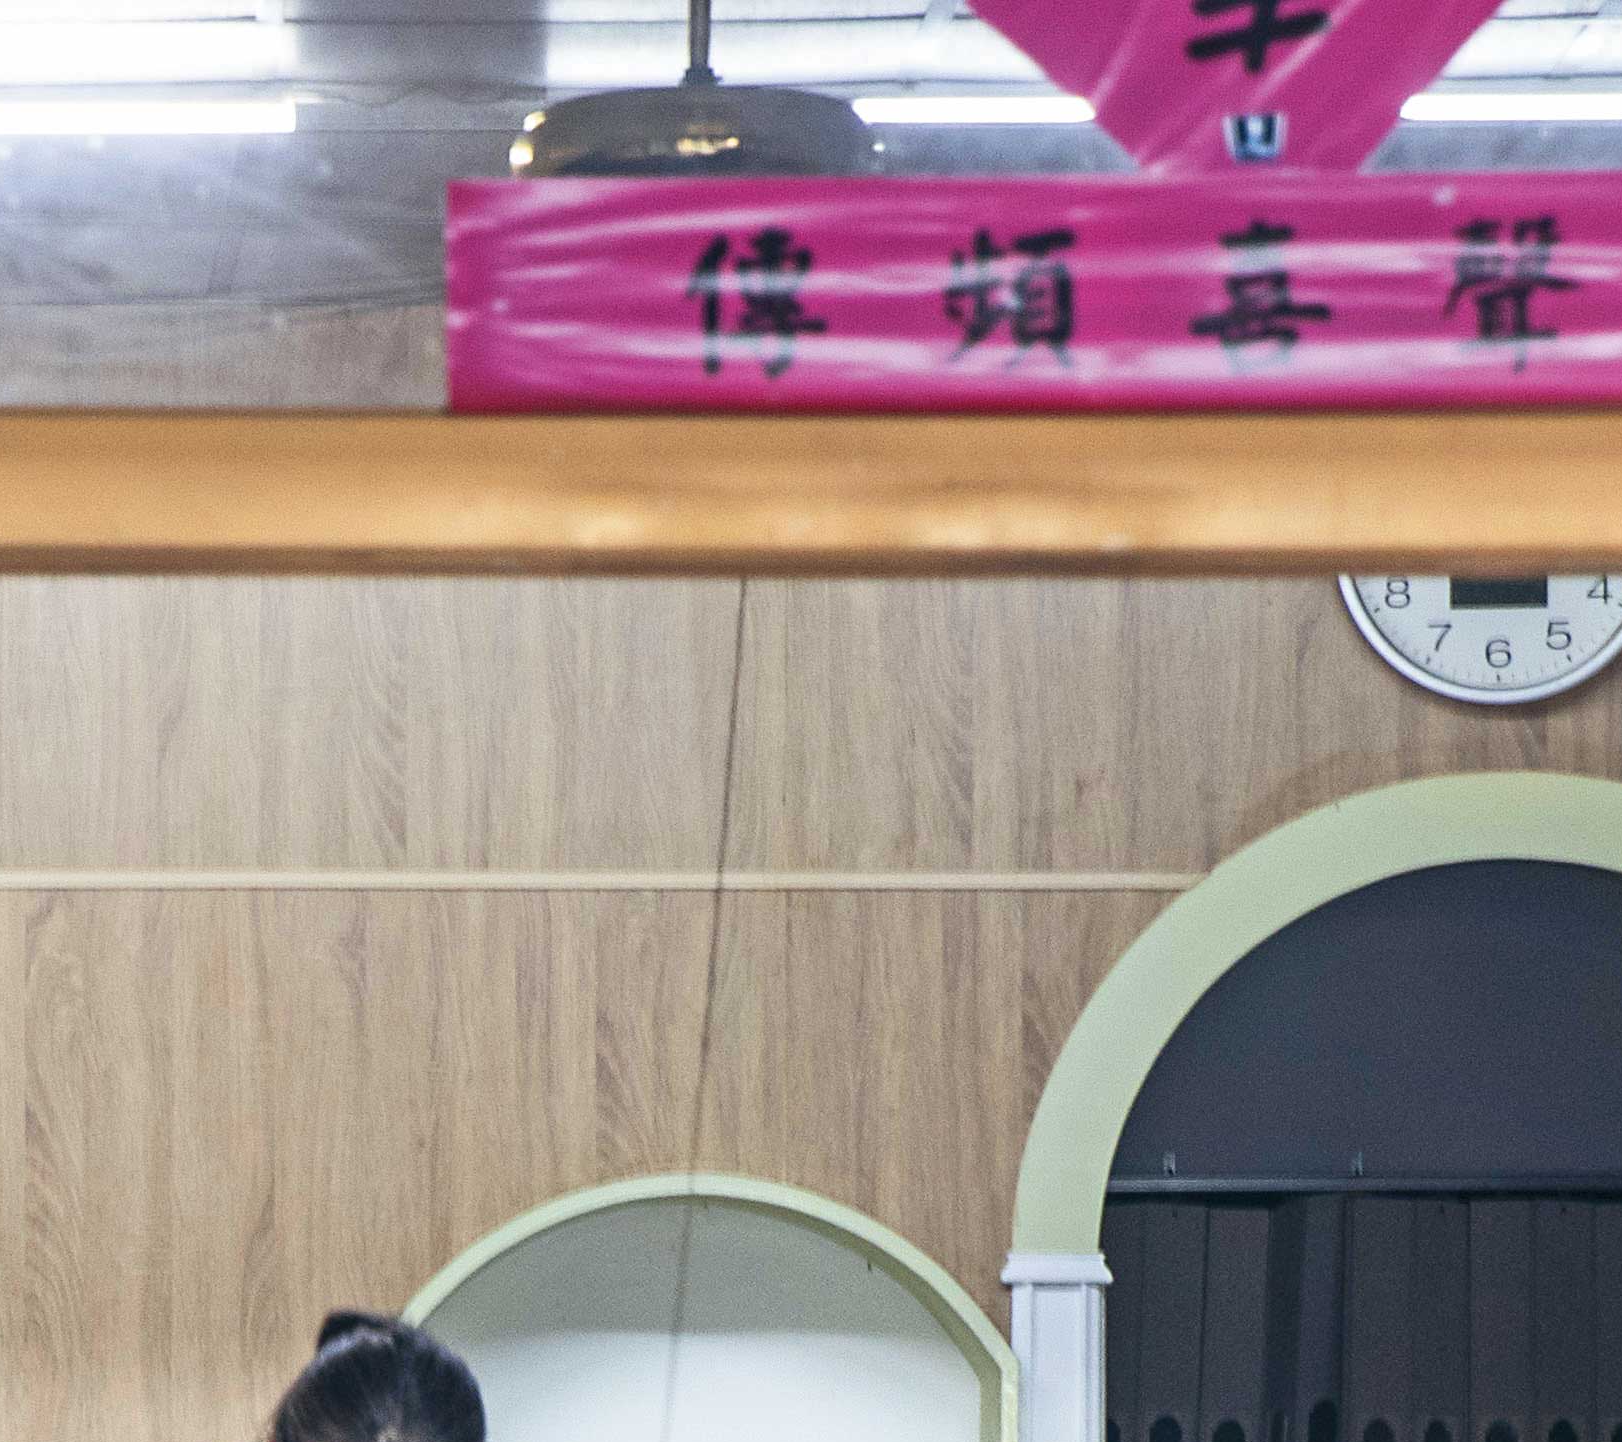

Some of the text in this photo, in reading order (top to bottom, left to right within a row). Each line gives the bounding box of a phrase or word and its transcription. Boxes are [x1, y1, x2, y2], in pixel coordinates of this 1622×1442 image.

[1586, 575, 1613, 604] 4
[1428, 624, 1453, 652] 7
[1545, 621, 1572, 650] 5
[1484, 639, 1512, 668] 6
